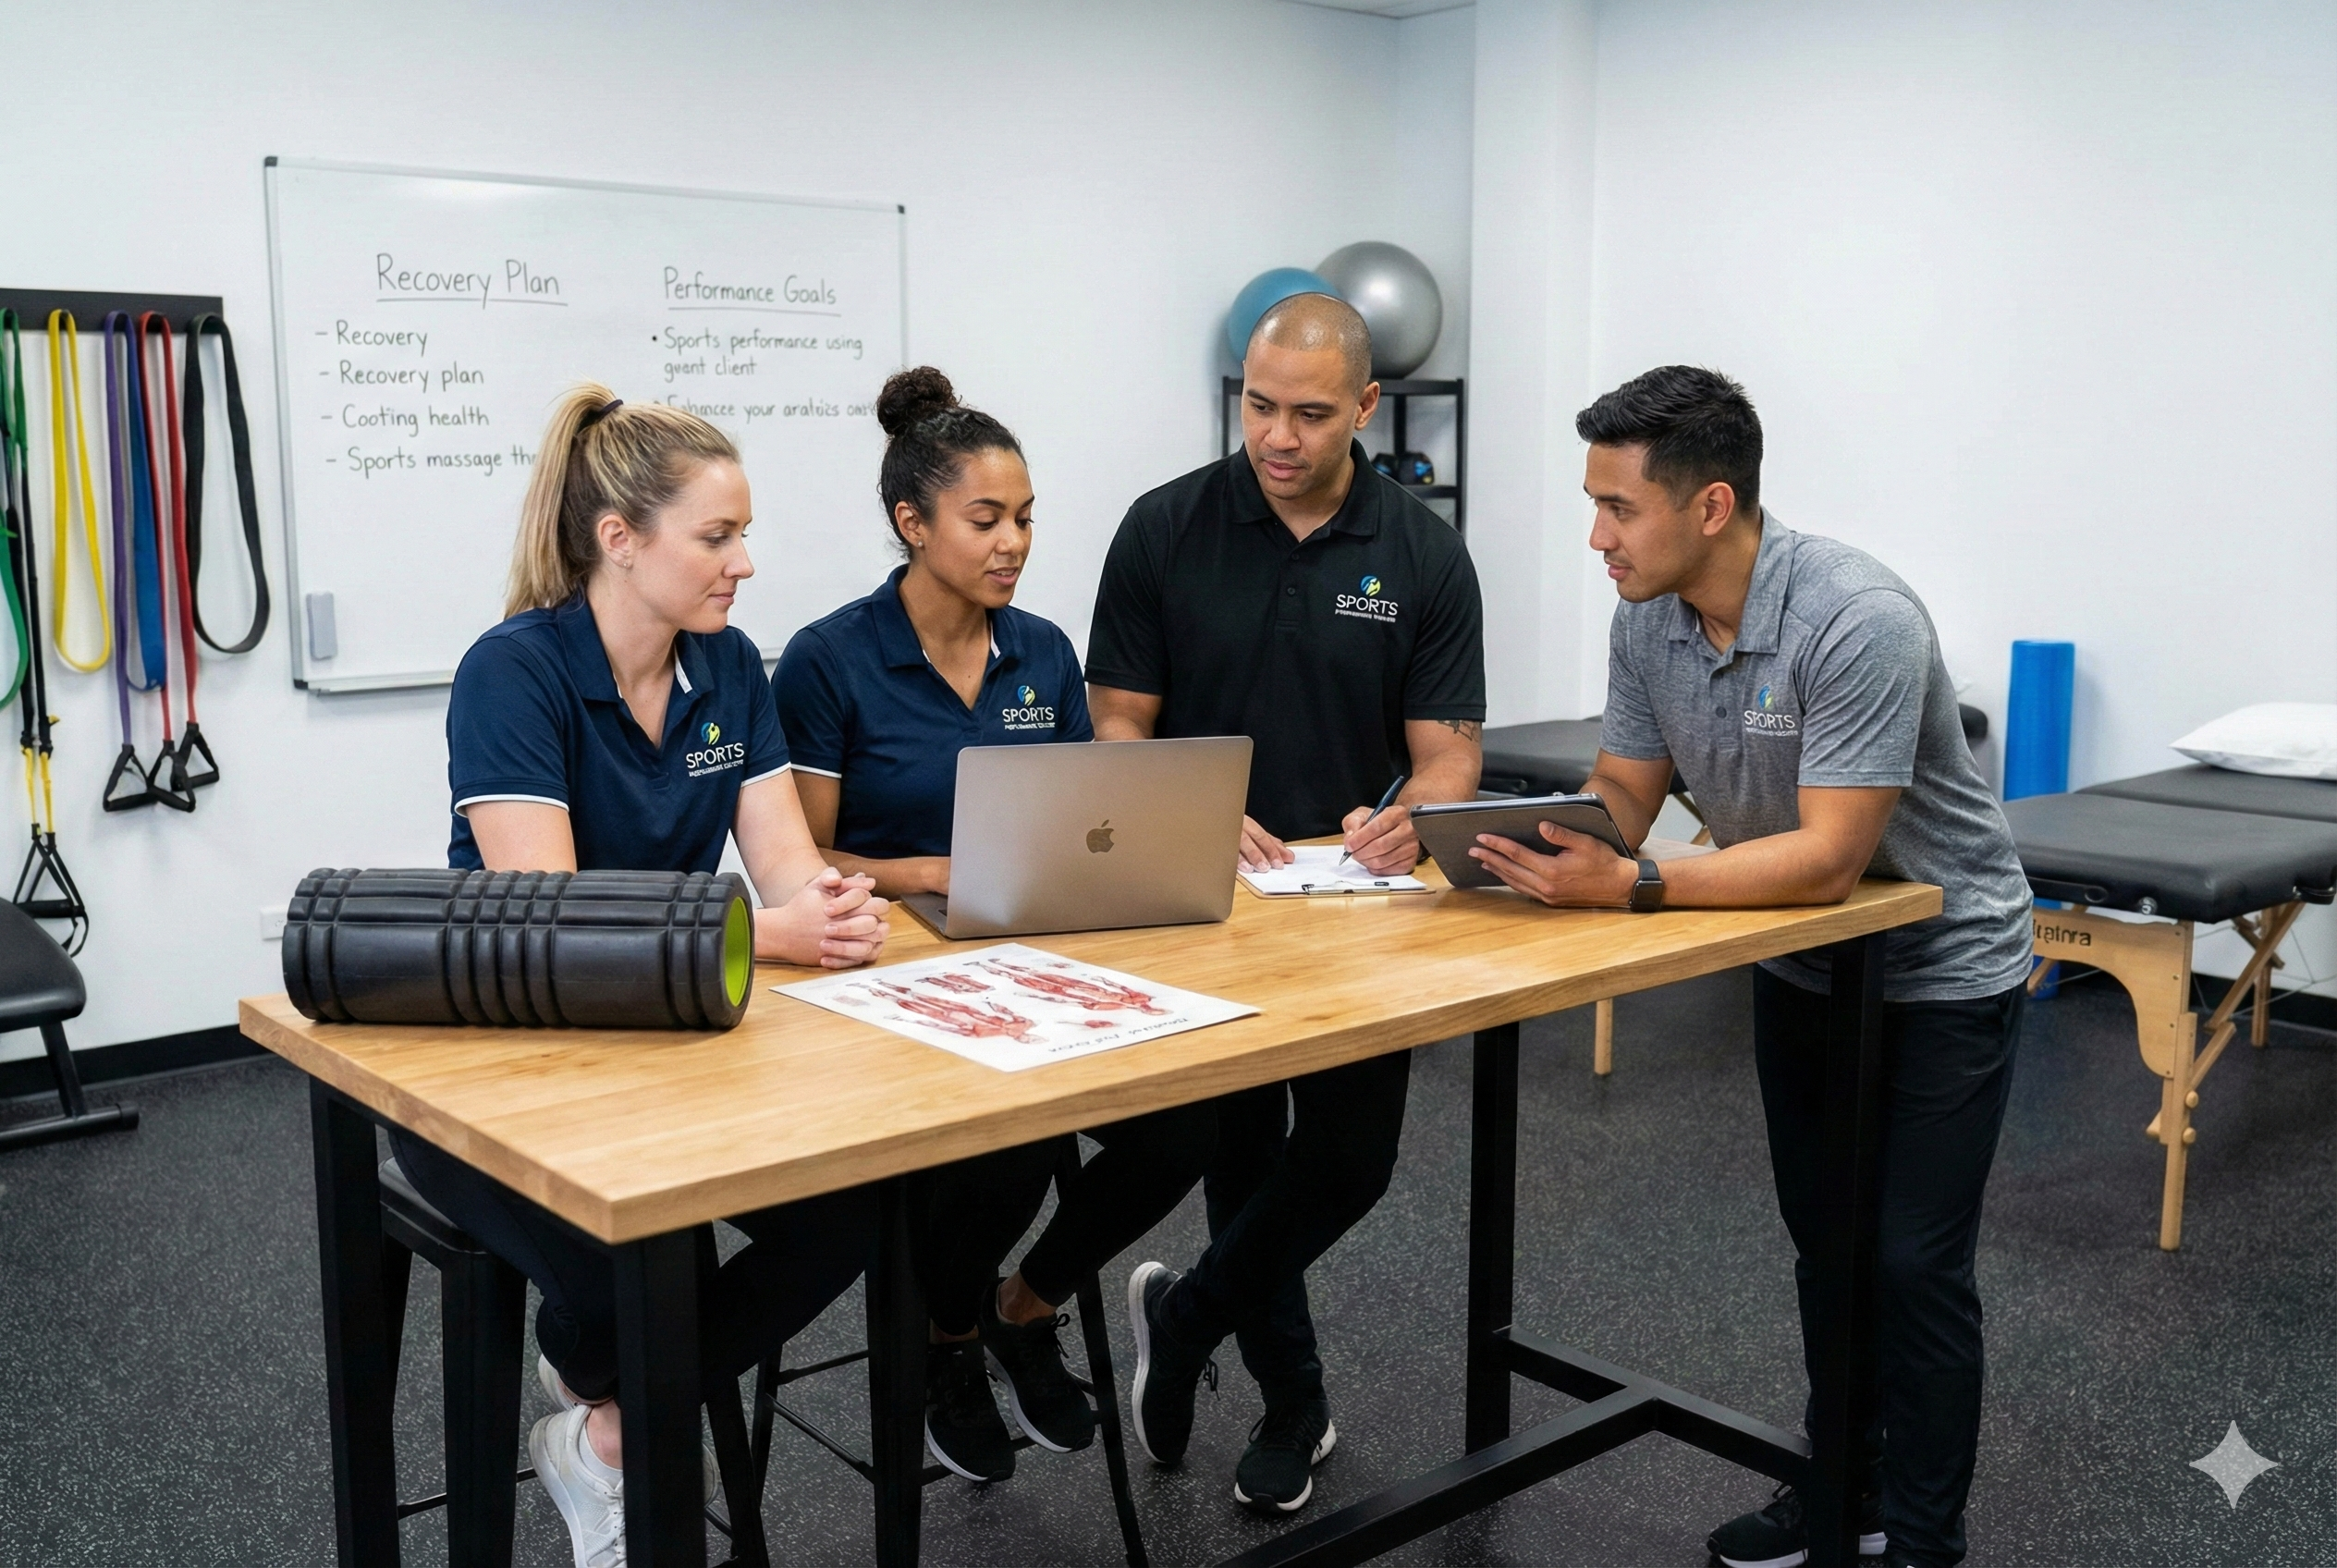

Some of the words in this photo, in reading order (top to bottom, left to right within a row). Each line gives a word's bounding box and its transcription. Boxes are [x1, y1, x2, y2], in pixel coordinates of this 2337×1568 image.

[375, 251, 492, 310] Recovery
[505, 259, 560, 295] Plan
[663, 265, 775, 300] Performance
[783, 275, 837, 305] Goals
[336, 319, 429, 358] Recovery
[664, 325, 721, 356] Sports
[730, 328, 818, 355] performance
[826, 335, 863, 361] using
[339, 359, 430, 394] Recovery
[440, 361, 484, 393] plan
[715, 354, 757, 376] client
[428, 404, 490, 426] health
[742, 404, 777, 425] your
[347, 446, 417, 480] Sports
[426, 452, 503, 477] massage
[1336, 594, 1399, 616] SPORTS
[1001, 706, 1055, 722] SPORTS
[686, 742, 745, 768] SPORTS
